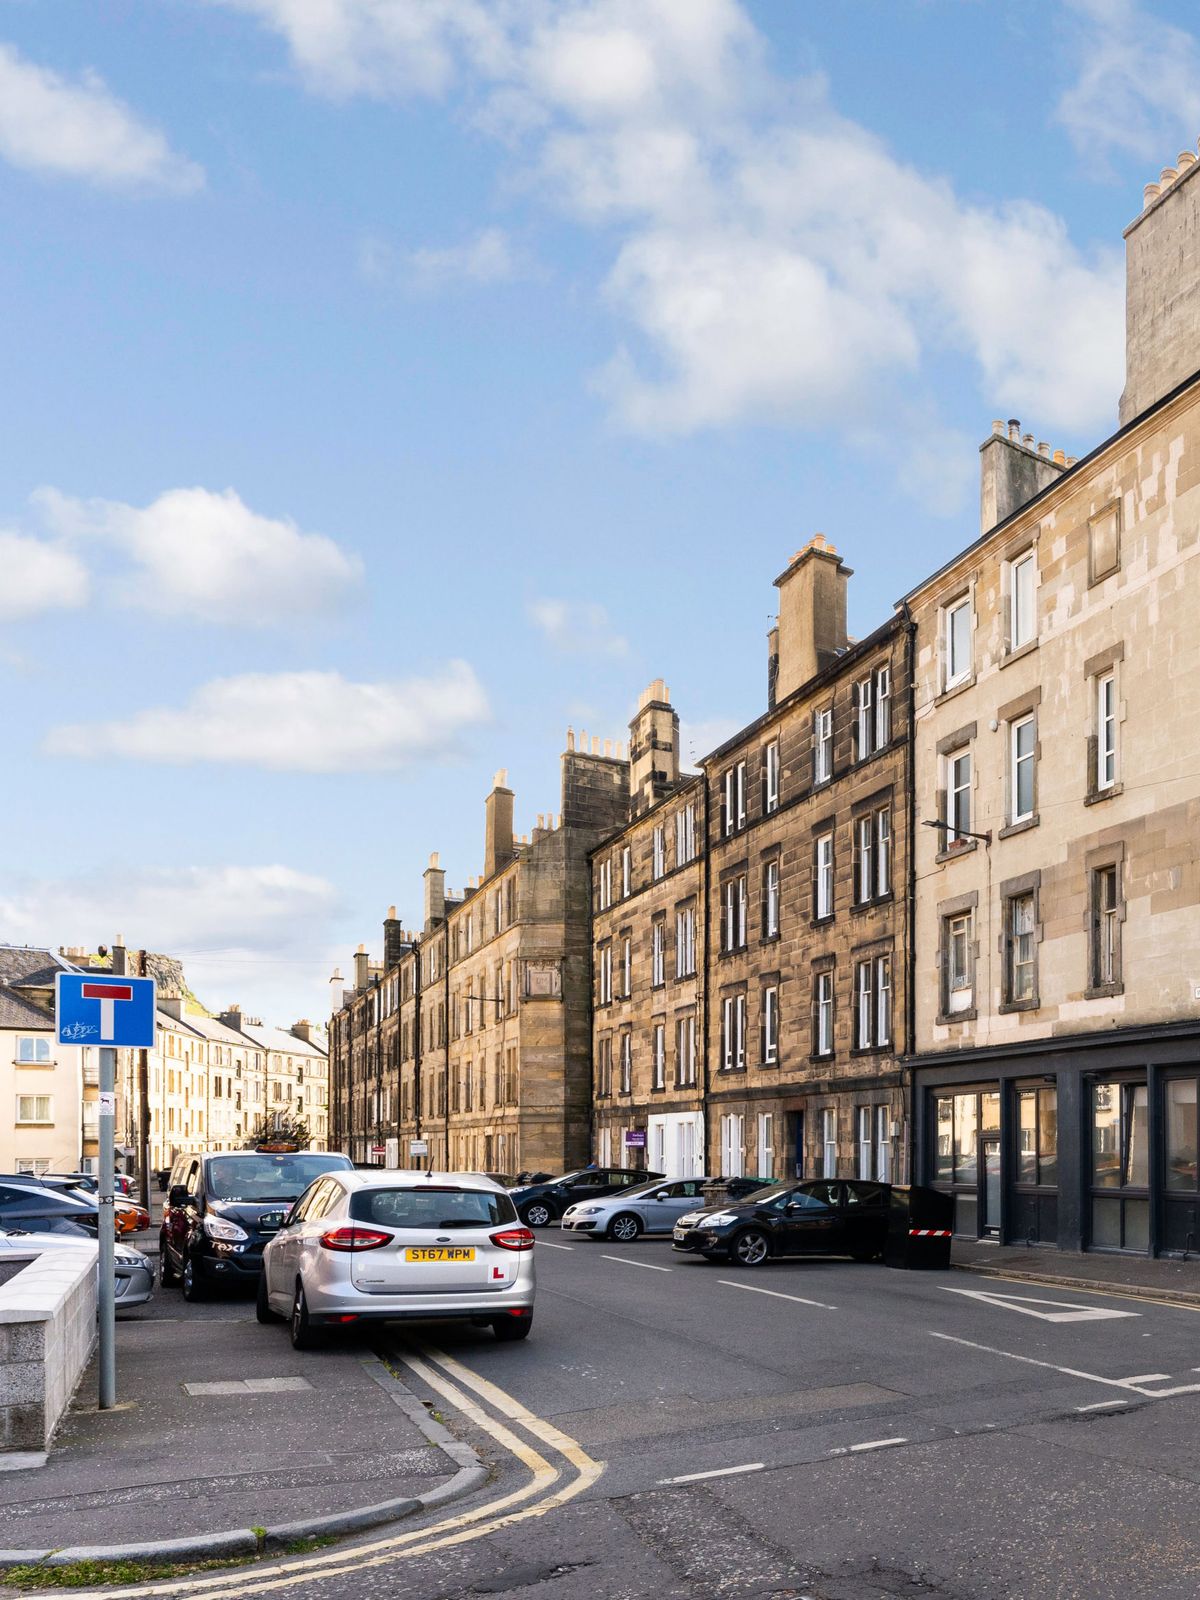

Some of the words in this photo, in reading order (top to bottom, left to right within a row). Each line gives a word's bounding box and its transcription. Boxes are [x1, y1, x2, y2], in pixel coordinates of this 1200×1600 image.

[411, 1249, 444, 1260] ST67
[447, 1249, 470, 1259] WPM
[493, 1267, 504, 1279] L
